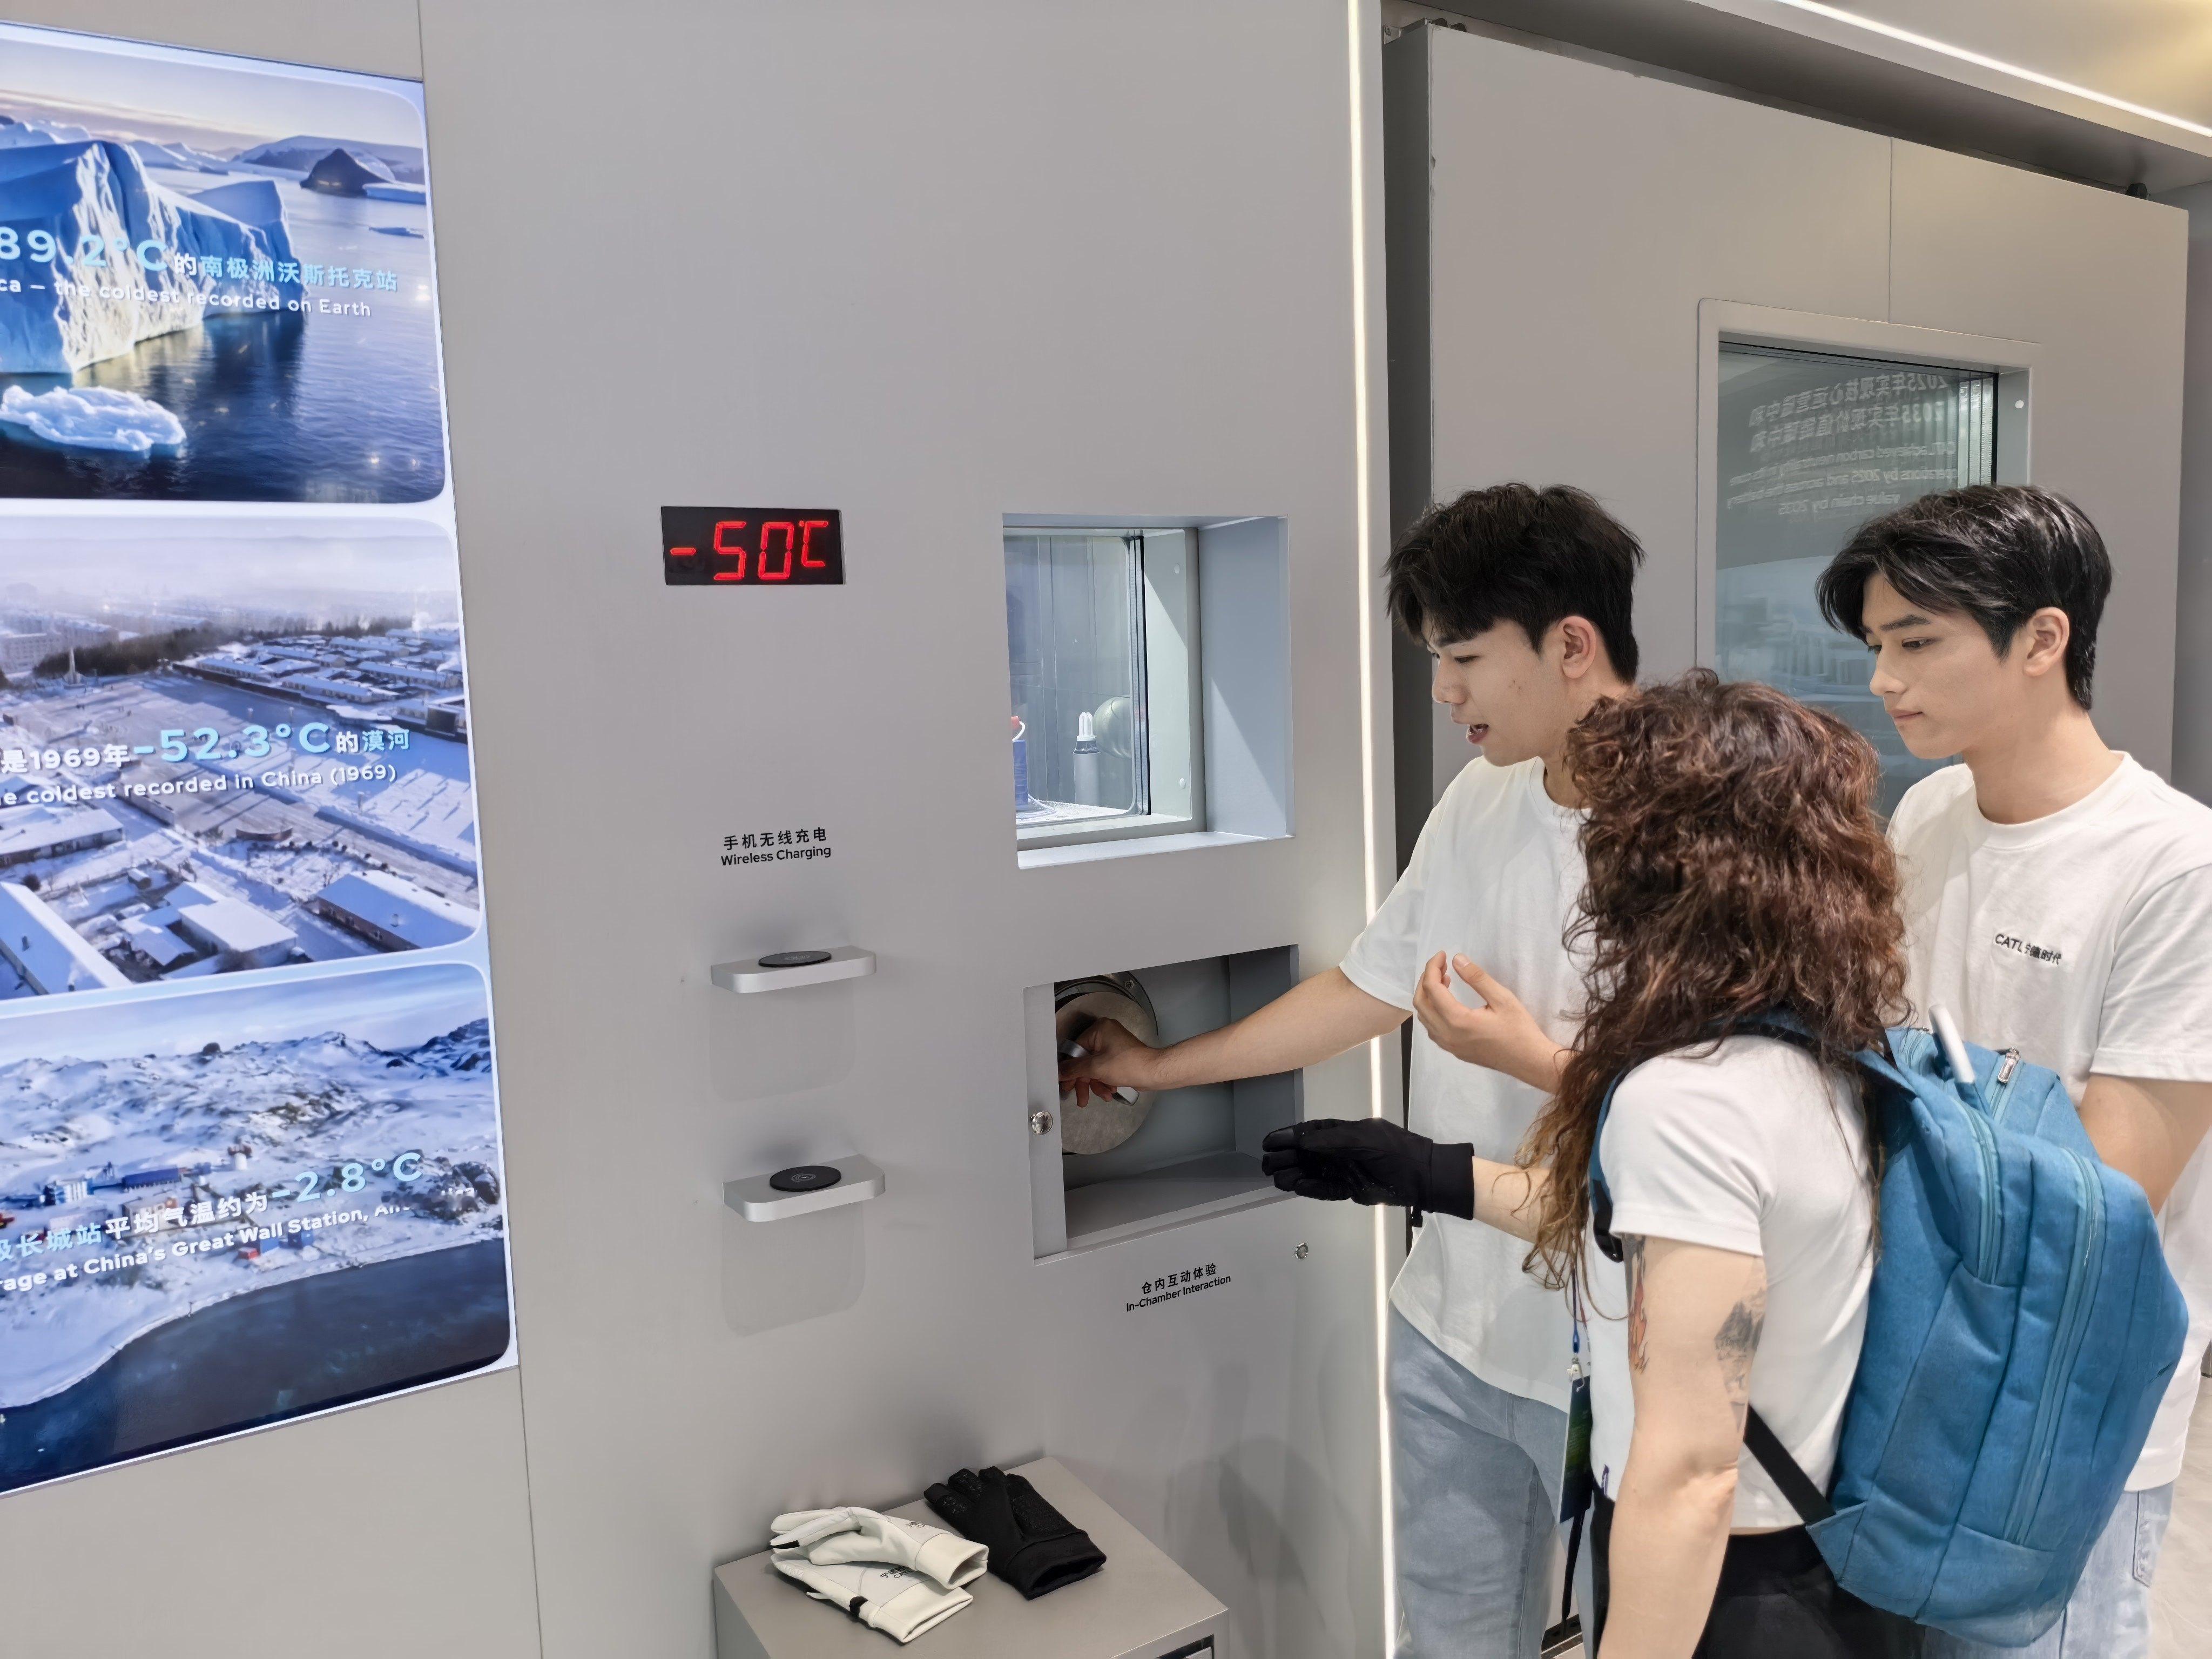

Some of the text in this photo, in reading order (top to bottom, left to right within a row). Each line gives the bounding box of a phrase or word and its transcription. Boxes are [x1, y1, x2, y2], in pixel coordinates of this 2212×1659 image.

[55, 279, 91, 297] the
[99, 284, 179, 303] coldest
[187, 291, 280, 311] recorded
[288, 299, 312, 312] on
[320, 299, 372, 316] Earth
[27, 783, 116, 804] coldest
[124, 774, 227, 797] recorded
[235, 773, 254, 790] in
[261, 770, 322, 787] China
[330, 764, 397, 786] (1969)
[721, 846, 831, 866] Wireless Charging
[723, 827, 827, 851] 手机无线充电
[1995, 933, 2023, 953] CATL
[0, 1271, 48, 1292] age
[53, 1263, 78, 1281] at
[172, 1232, 234, 1257] Great
[239, 1222, 283, 1243] Wall
[288, 1209, 369, 1233] Station,
[1126, 1275, 1231, 1312] In-Chamber Interaction
[1141, 1263, 1216, 1294] 仓内互动体验
